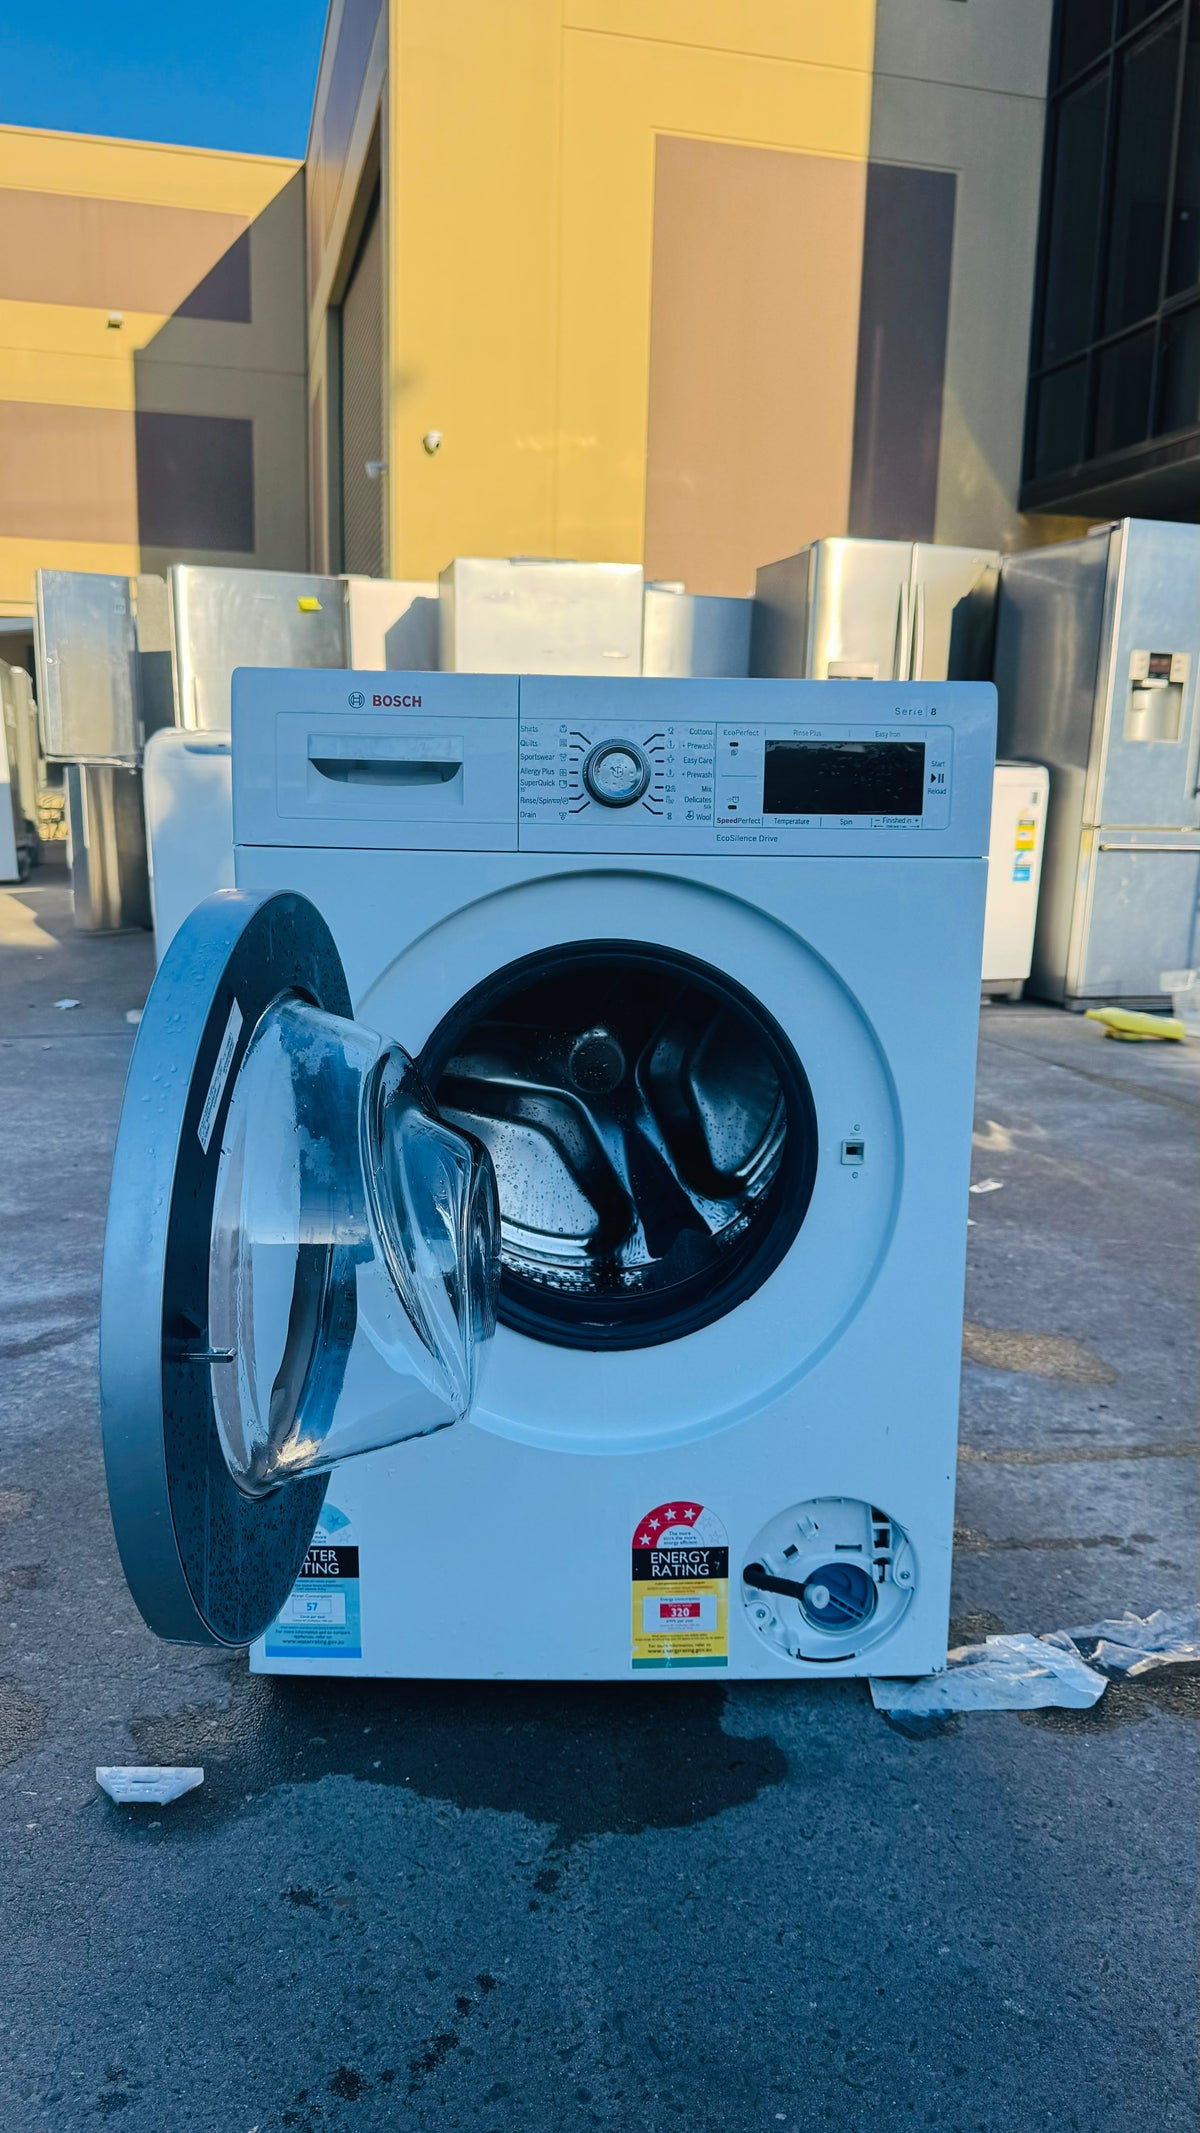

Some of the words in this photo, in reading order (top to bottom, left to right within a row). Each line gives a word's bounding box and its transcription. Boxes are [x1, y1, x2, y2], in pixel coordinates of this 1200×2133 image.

[372, 694, 422, 707] BOSCH
[895, 707, 923, 716] Serie
[930, 708, 936, 716] 8
[875, 730, 888, 739] Easy
[684, 757, 697, 765] Easy
[520, 768, 541, 776] Allergy
[305, 1550, 338, 1561] TER
[650, 1551, 710, 1564] ENERGY
[301, 1562, 339, 1575] TING
[652, 1564, 709, 1577] RATING
[307, 1603, 318, 1611] 57
[671, 1608, 690, 1616] 320
